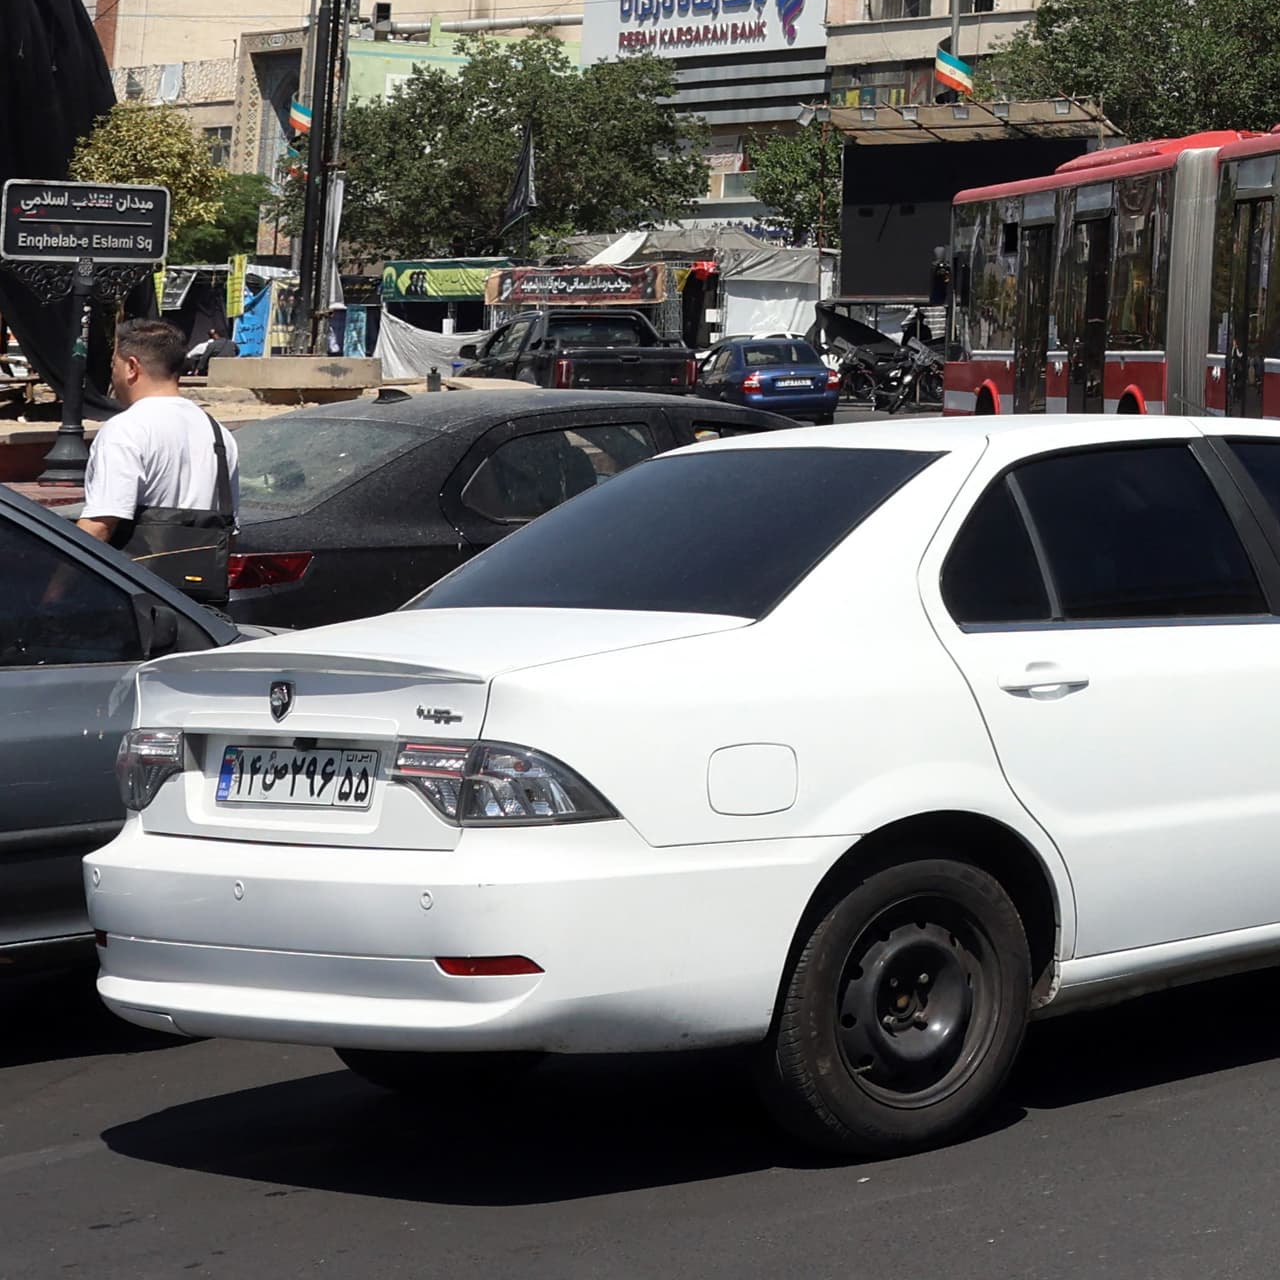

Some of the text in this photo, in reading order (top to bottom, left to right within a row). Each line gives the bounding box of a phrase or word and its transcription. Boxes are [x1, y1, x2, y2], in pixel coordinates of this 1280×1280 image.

[730, 19, 767, 40] BANK
[20, 191, 154, 215] میدان انقلاب اسلامی
[93, 235, 134, 249] Eslami
[136, 236, 153, 252] Sq
[346, 753, 373, 763] ایران
